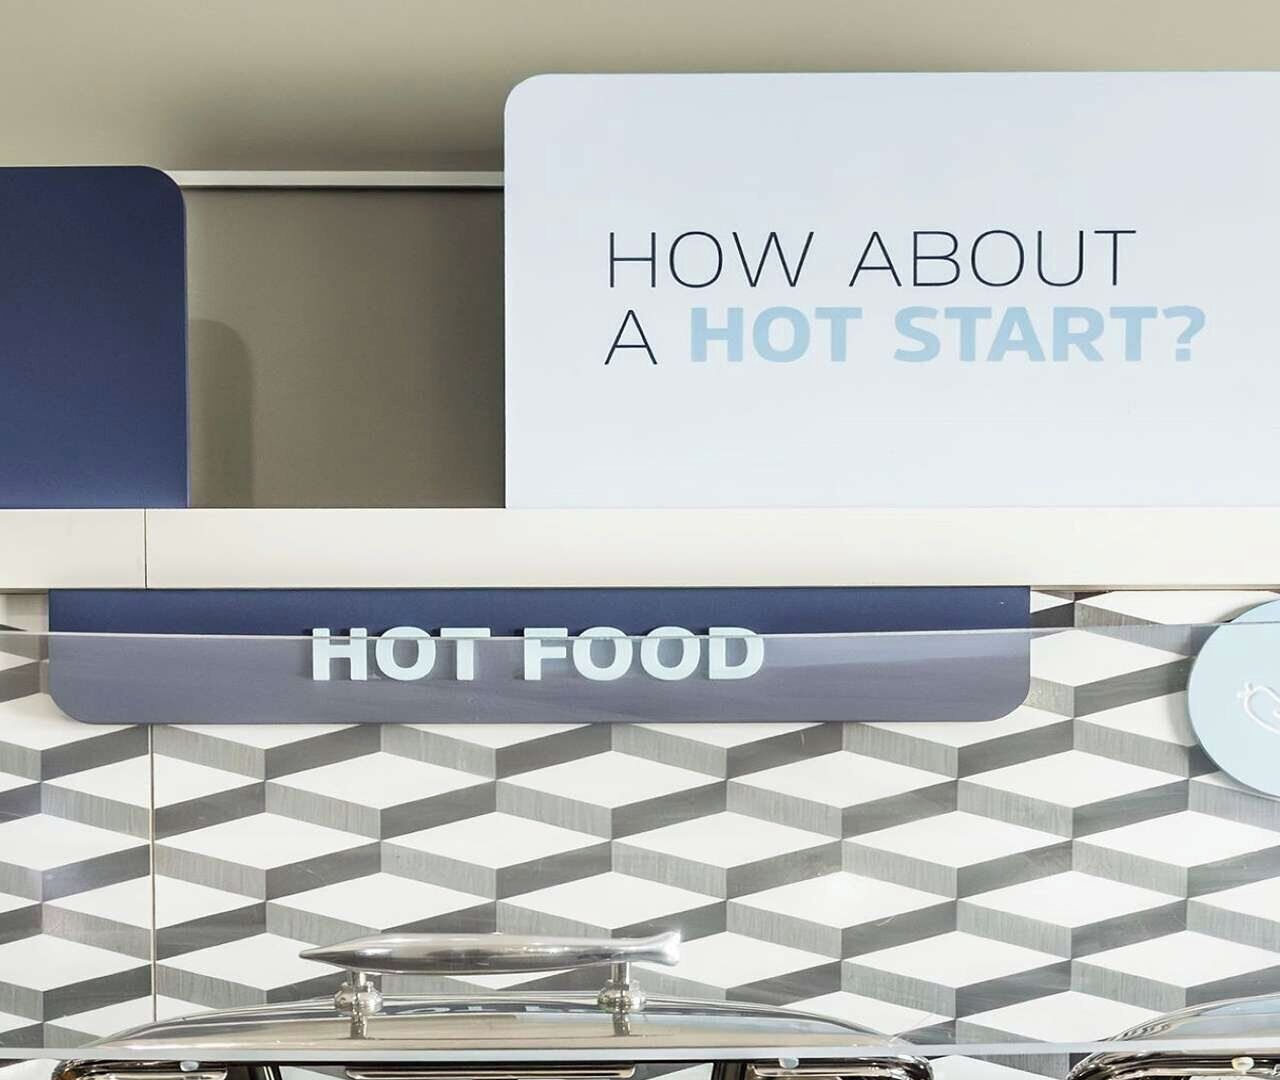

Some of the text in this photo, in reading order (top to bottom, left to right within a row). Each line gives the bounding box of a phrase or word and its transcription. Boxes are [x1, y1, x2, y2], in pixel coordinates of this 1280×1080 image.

[608, 229, 1138, 289] HOW ABOUT
[604, 305, 1208, 367] A HOT START?
[312, 626, 766, 681] HOT FOOD
